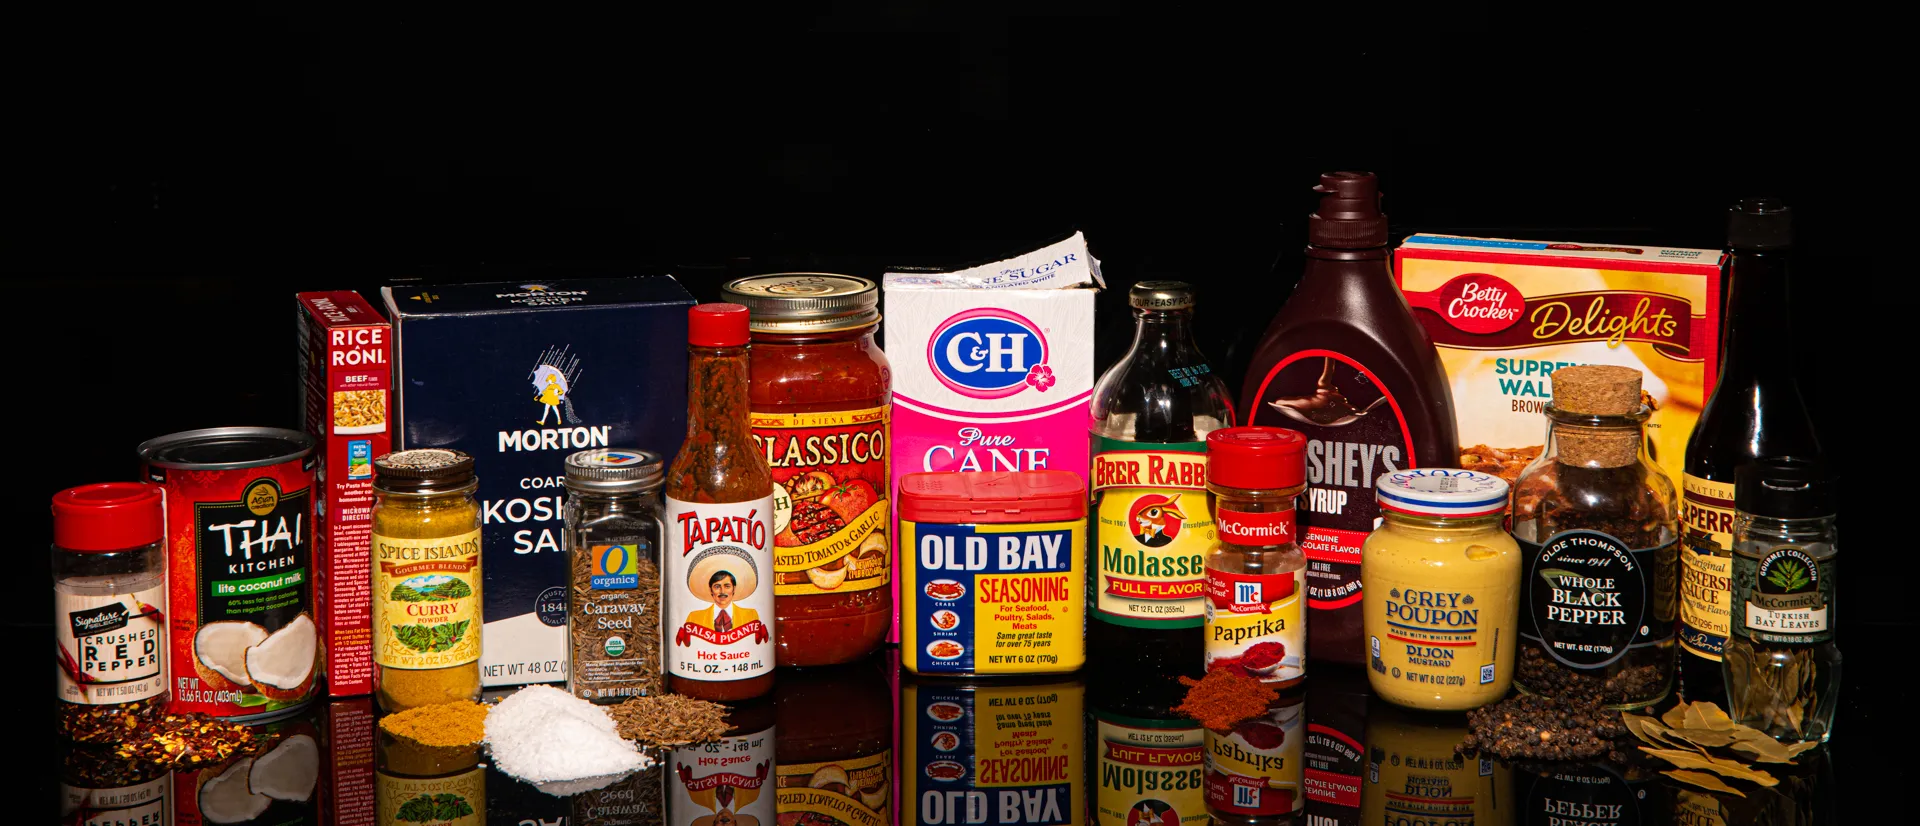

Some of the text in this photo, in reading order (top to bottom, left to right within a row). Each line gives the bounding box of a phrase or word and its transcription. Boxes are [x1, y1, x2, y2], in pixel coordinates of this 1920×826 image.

[1009, 253, 1077, 281] SUGAR
[1031, 273, 1055, 284] WHITE
[1461, 281, 1507, 306] Betty
[1155, 298, 1178, 307] EASY
[1448, 298, 1513, 321] Crocker
[1530, 296, 1677, 349] Delights
[332, 329, 382, 346] RICE
[946, 331, 1028, 373] C&H
[1499, 378, 1550, 398] WAL
[793, 417, 845, 426] DI SIENA
[499, 425, 608, 452] MORTON
[958, 427, 1016, 447] Pure
[923, 445, 1050, 473] CANE
[1307, 439, 1400, 488] SHEY'S
[1096, 455, 1206, 487] BRER RABB
[520, 476, 565, 490] COAR
[1218, 517, 1289, 536] McCormick
[1690, 504, 1733, 534] PERR
[208, 512, 303, 560] THAI
[677, 509, 765, 557] TAPATÍO
[805, 511, 880, 564] TOMATO GARLIC
[1305, 532, 1338, 543] GENUINE
[380, 537, 478, 560] SPICE ISLANDS
[921, 534, 988, 571] OLD
[998, 534, 1063, 570] BAY
[1302, 542, 1360, 554] COLATE FLAVOR
[1542, 537, 1634, 572] OLDE THOMPSON
[229, 555, 295, 574] KITCHEN
[1103, 545, 1202, 577] Molasse
[1311, 561, 1331, 572] FAT FREE
[1557, 555, 1585, 564] since
[1760, 549, 1817, 582] GOURMET COLLECTION
[395, 564, 435, 575] GOURMET
[218, 572, 301, 594] lite coconut milk
[594, 576, 635, 588] organics
[1113, 581, 1203, 595] FULL FLAVOR
[1558, 575, 1615, 590] WHOLE
[600, 593, 629, 601] organic
[980, 576, 1069, 604] SEASONING
[1552, 588, 1622, 607] BLACK
[1684, 581, 1719, 604] SAUCE
[1404, 588, 1461, 608] GREY
[1755, 593, 1816, 608] McCormick
[407, 602, 459, 616] CURRY
[584, 602, 646, 616] Caraway
[1000, 604, 1049, 613] For Seafood,
[1129, 604, 1139, 612] NET
[1230, 604, 1267, 613] McCormick
[1385, 600, 1479, 626] POUPON
[1547, 605, 1626, 625] PEPPER
[1767, 611, 1810, 619] TURKISH
[75, 610, 119, 630] Signature
[417, 615, 449, 624] POWDER
[598, 616, 632, 630] Seed
[994, 613, 1055, 622] Poultry, Salads,
[1755, 615, 1819, 629] BAY LEAVES
[685, 621, 760, 644] SALSA PICANTE
[1012, 622, 1038, 630] Meats
[1214, 618, 1285, 645] Paprika
[1391, 627, 1407, 636] MADE
[85, 629, 155, 645] CRUSHED
[996, 631, 1053, 641] Same great taste
[85, 640, 155, 660] RED
[995, 640, 1007, 648] for
[1033, 640, 1051, 649] years
[1406, 644, 1454, 659] DIJON
[1554, 641, 1613, 653] NET OZ (170g)
[86, 654, 156, 671] PEPPER
[697, 650, 750, 660] Hot Sauce
[989, 654, 1058, 665] NET WT 6 OZ (170g)
[1408, 657, 1451, 667] MUSTARD
[483, 660, 558, 678] NET WT 48 OZ
[687, 659, 763, 674] FL. OZ. 148 mL
[178, 677, 199, 689] NET WT
[1407, 671, 1466, 686] NET WT OZ (227g)
[96, 688, 115, 697] NET WT
[203, 690, 213, 702] OZ
[598, 689, 607, 697] NET
